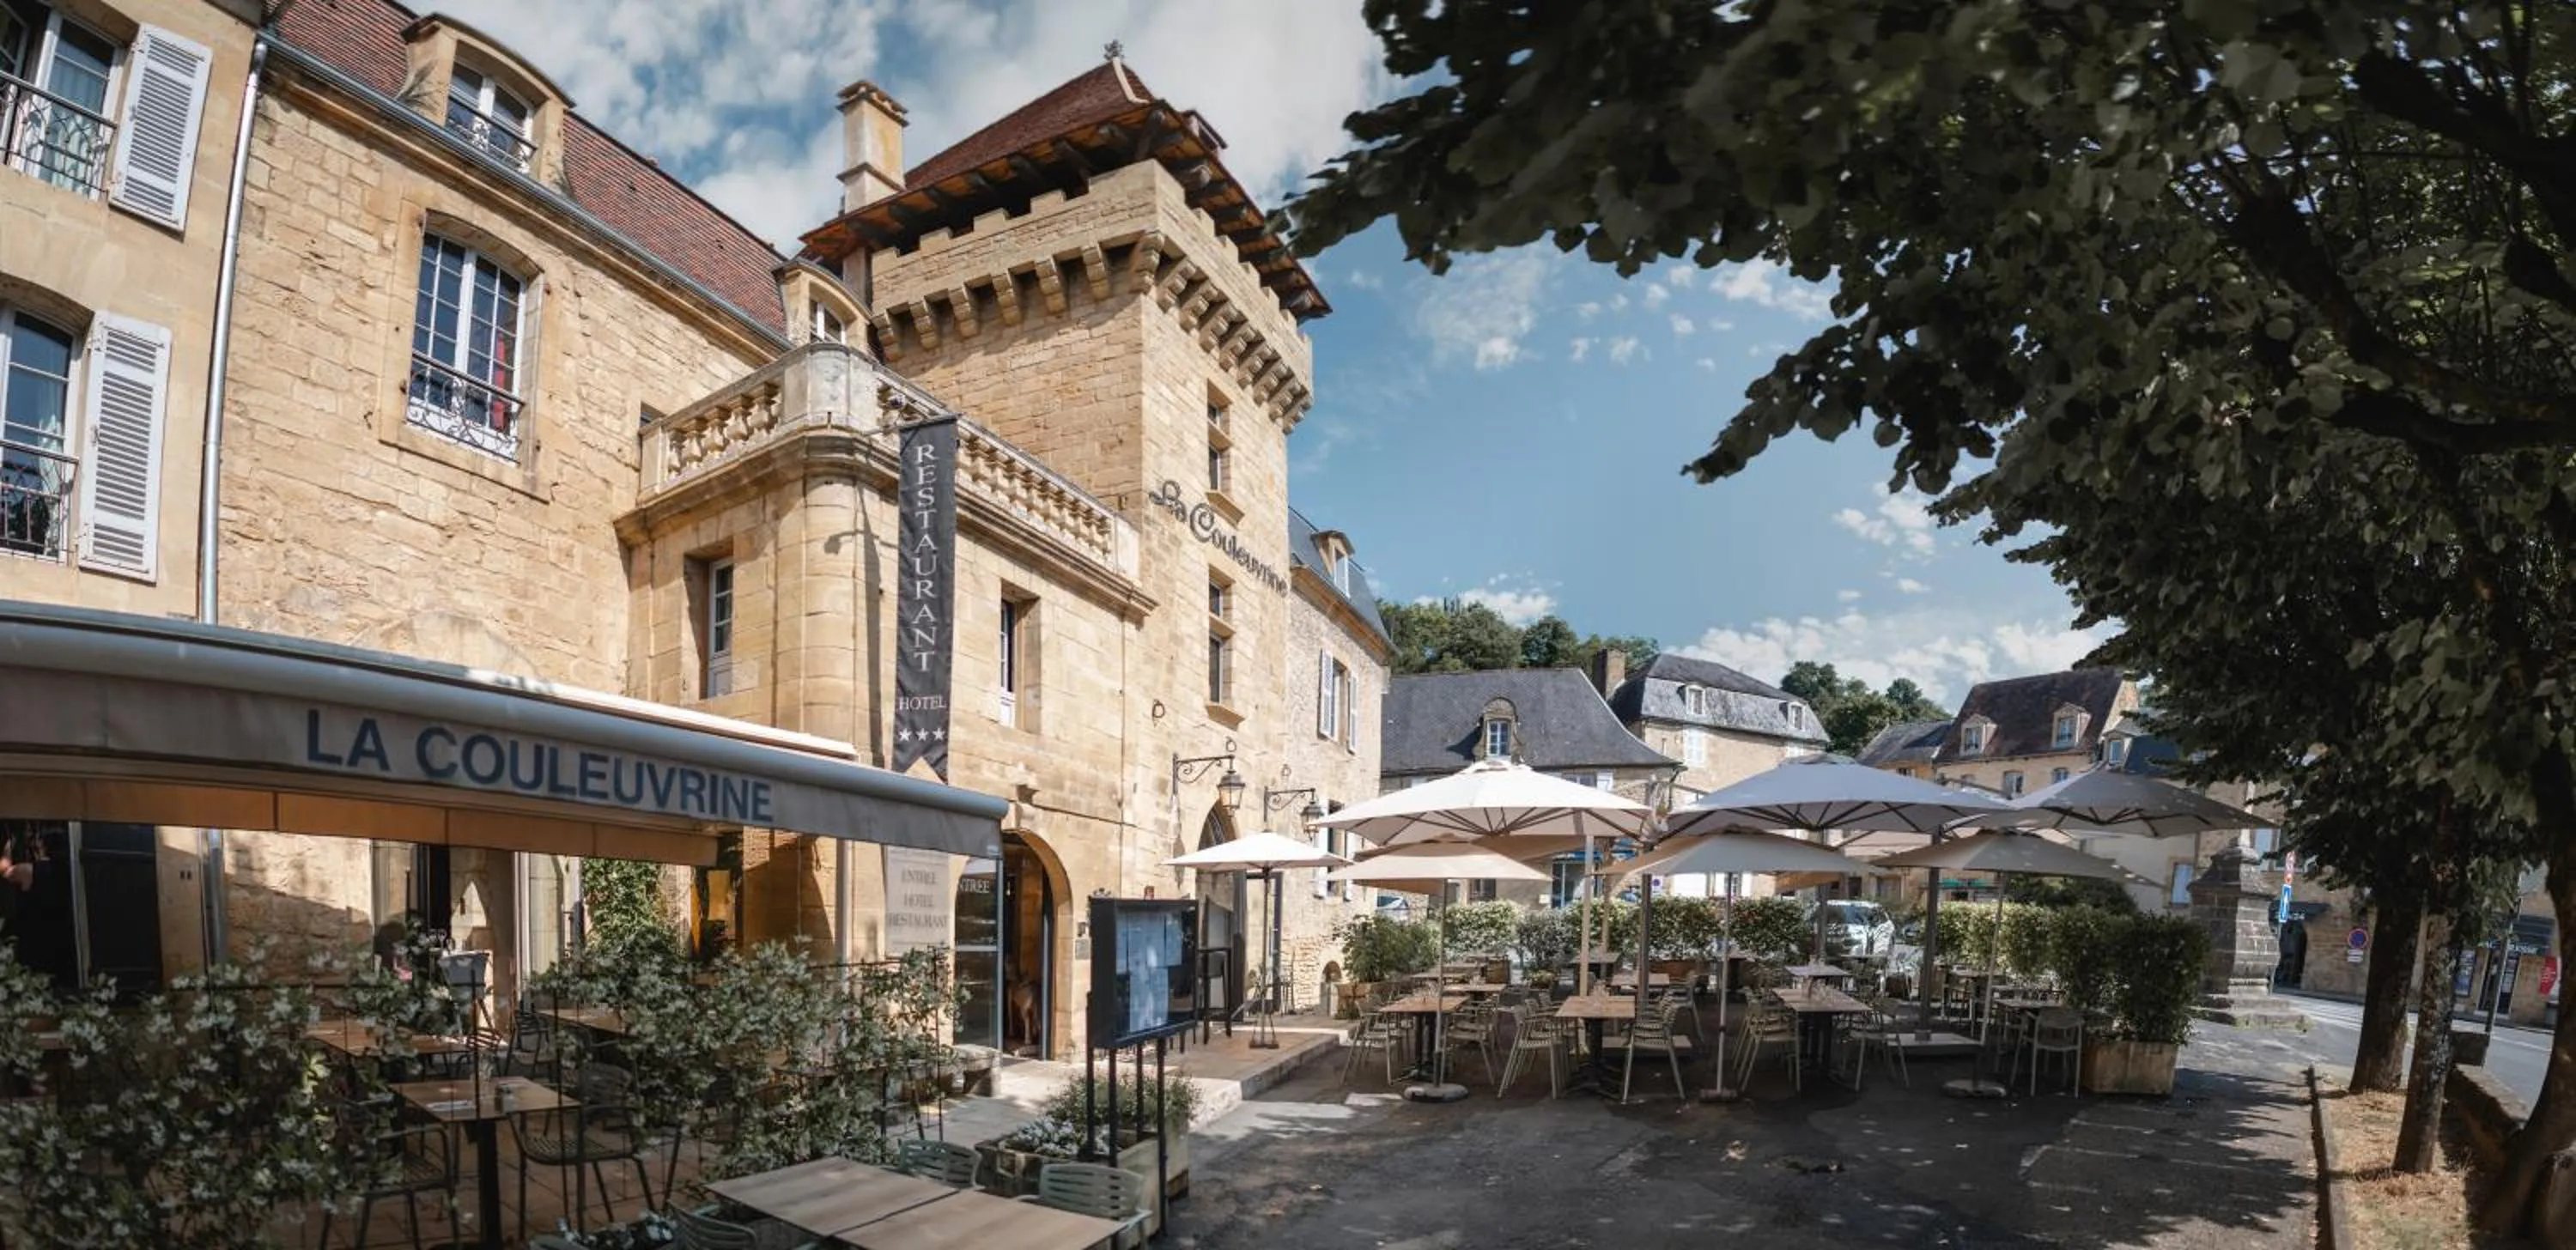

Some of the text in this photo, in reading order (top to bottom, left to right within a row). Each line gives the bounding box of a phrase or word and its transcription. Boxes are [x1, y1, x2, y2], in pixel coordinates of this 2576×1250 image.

[914, 443, 939, 672] RESTAURANT
[1148, 479, 1288, 598] La Couleuvrine
[898, 695, 947, 711] HOTEL
[307, 708, 775, 823] LA COULEUVRINE
[887, 912, 949, 928] RESTAURANT
